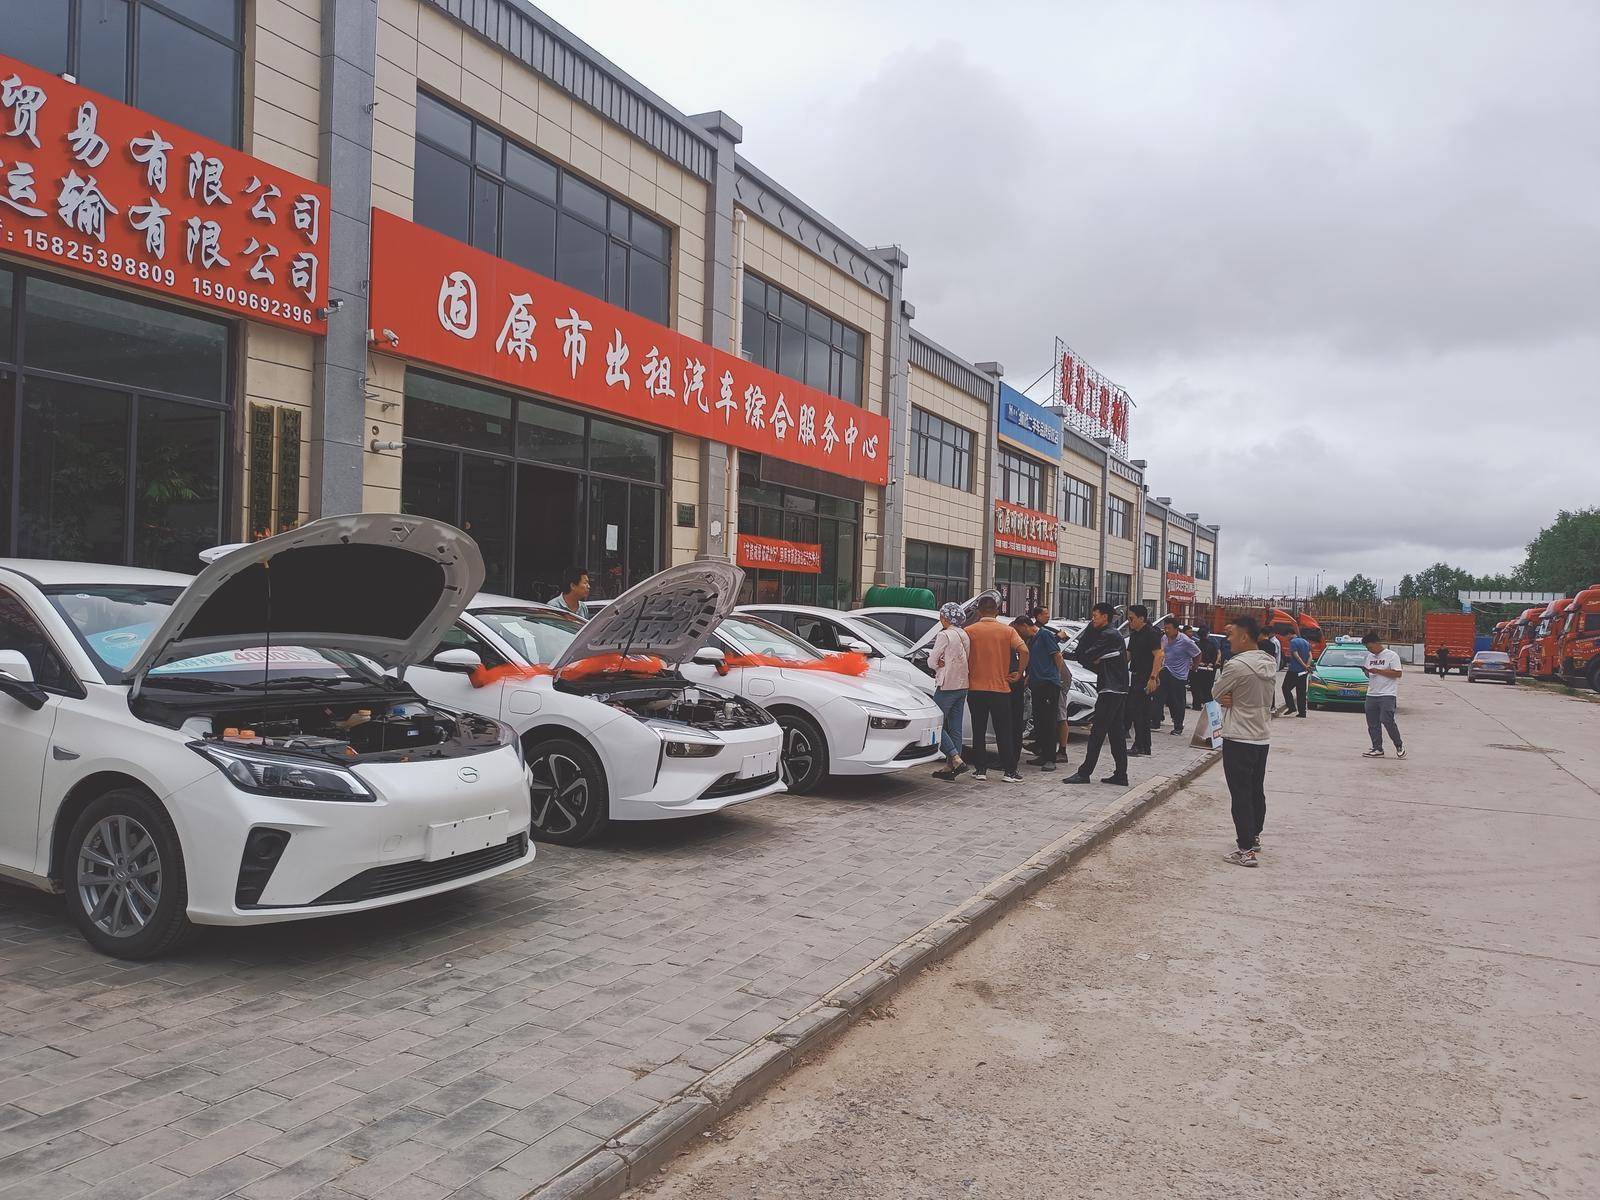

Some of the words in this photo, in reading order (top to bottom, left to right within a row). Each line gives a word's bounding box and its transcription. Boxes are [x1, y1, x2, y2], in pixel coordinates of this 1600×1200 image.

[0, 159, 320, 303] 运输有限公司
[1, 73, 321, 246] 贸易有限公司
[192, 277, 312, 325] 15909692396
[437, 270, 880, 463] 固原市出租汽车综合服务中心
